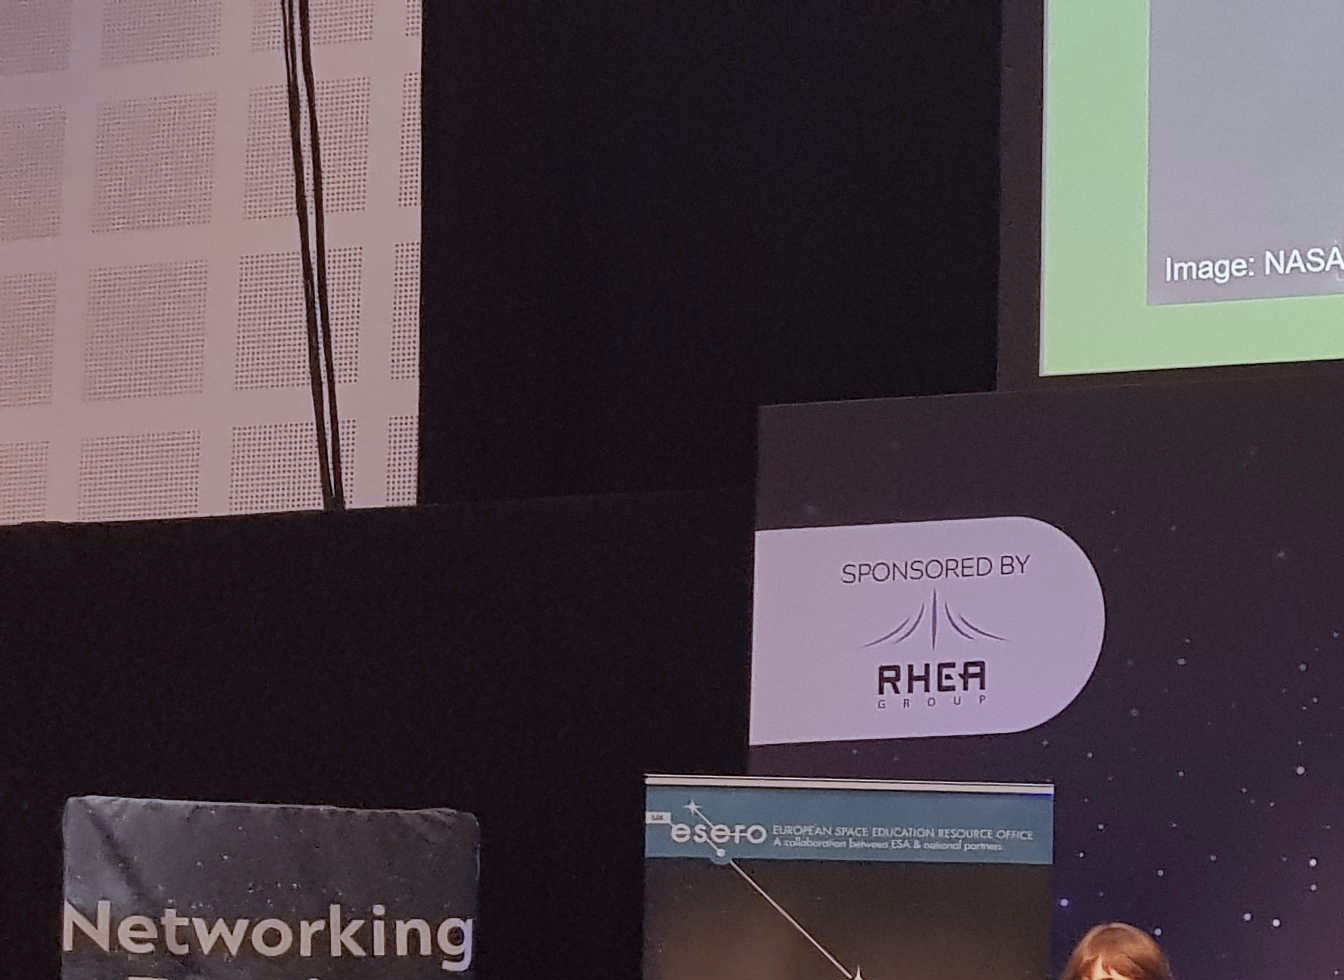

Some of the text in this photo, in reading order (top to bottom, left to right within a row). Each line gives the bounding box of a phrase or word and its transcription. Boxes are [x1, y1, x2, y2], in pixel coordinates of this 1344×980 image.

[1165, 255, 1256, 285] Image:
[841, 555, 1032, 585] SPONSORED BY
[878, 661, 986, 695] RHEA
[877, 694, 986, 710] GROUP
[671, 824, 767, 844] esero
[773, 825, 1033, 841] EUROPEAN SPACE EDUCATION RESOURCE OFFICE
[774, 837, 782, 847] A
[786, 836, 846, 848] collaboration
[850, 838, 888, 849] between
[892, 839, 911, 849] ESA
[924, 839, 961, 850] national
[964, 842, 1002, 852] partners
[62, 901, 473, 972] Networking
